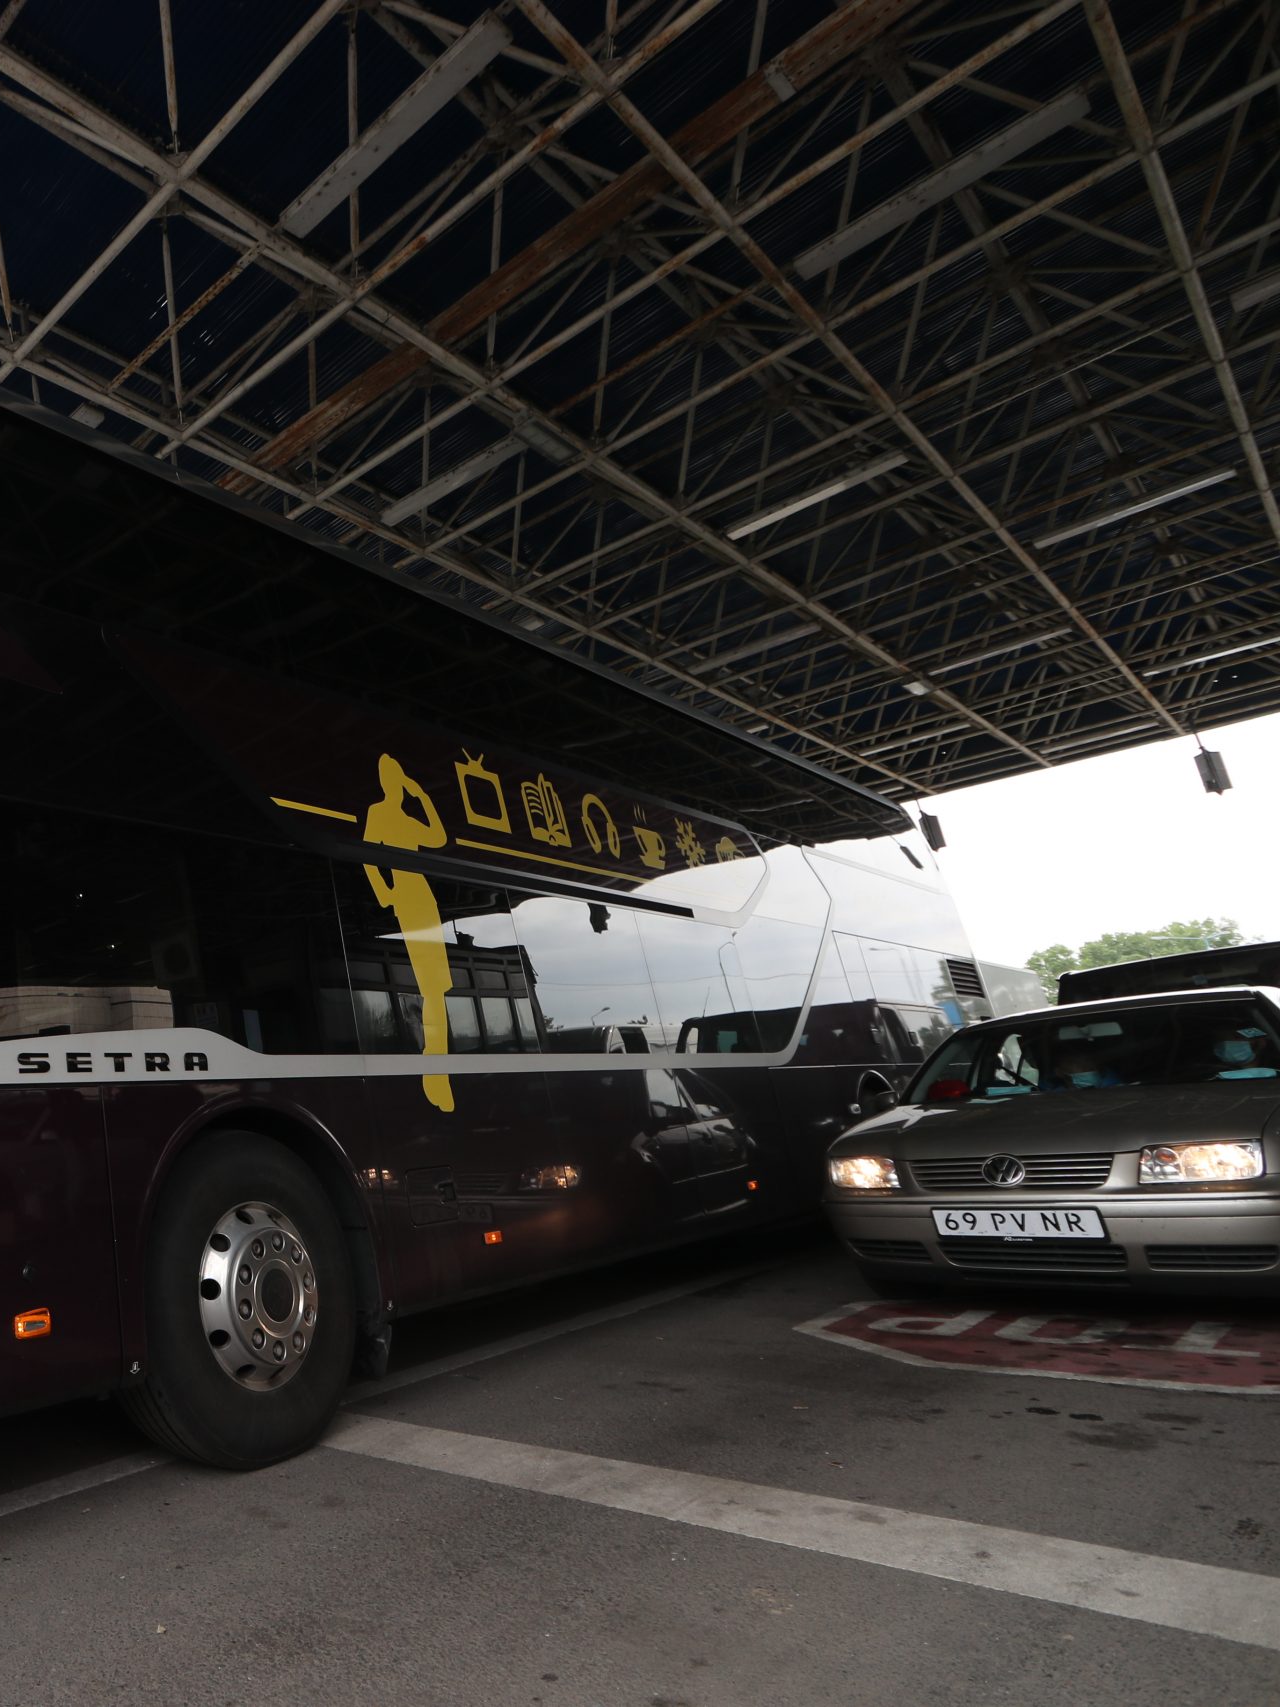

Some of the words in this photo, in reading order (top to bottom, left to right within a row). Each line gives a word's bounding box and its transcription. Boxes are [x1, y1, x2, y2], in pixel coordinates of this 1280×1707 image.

[17, 1052, 209, 1074] SETRA
[944, 1212, 977, 1231] 69
[990, 1213, 1025, 1232] PV
[1040, 1212, 1085, 1232] NR
